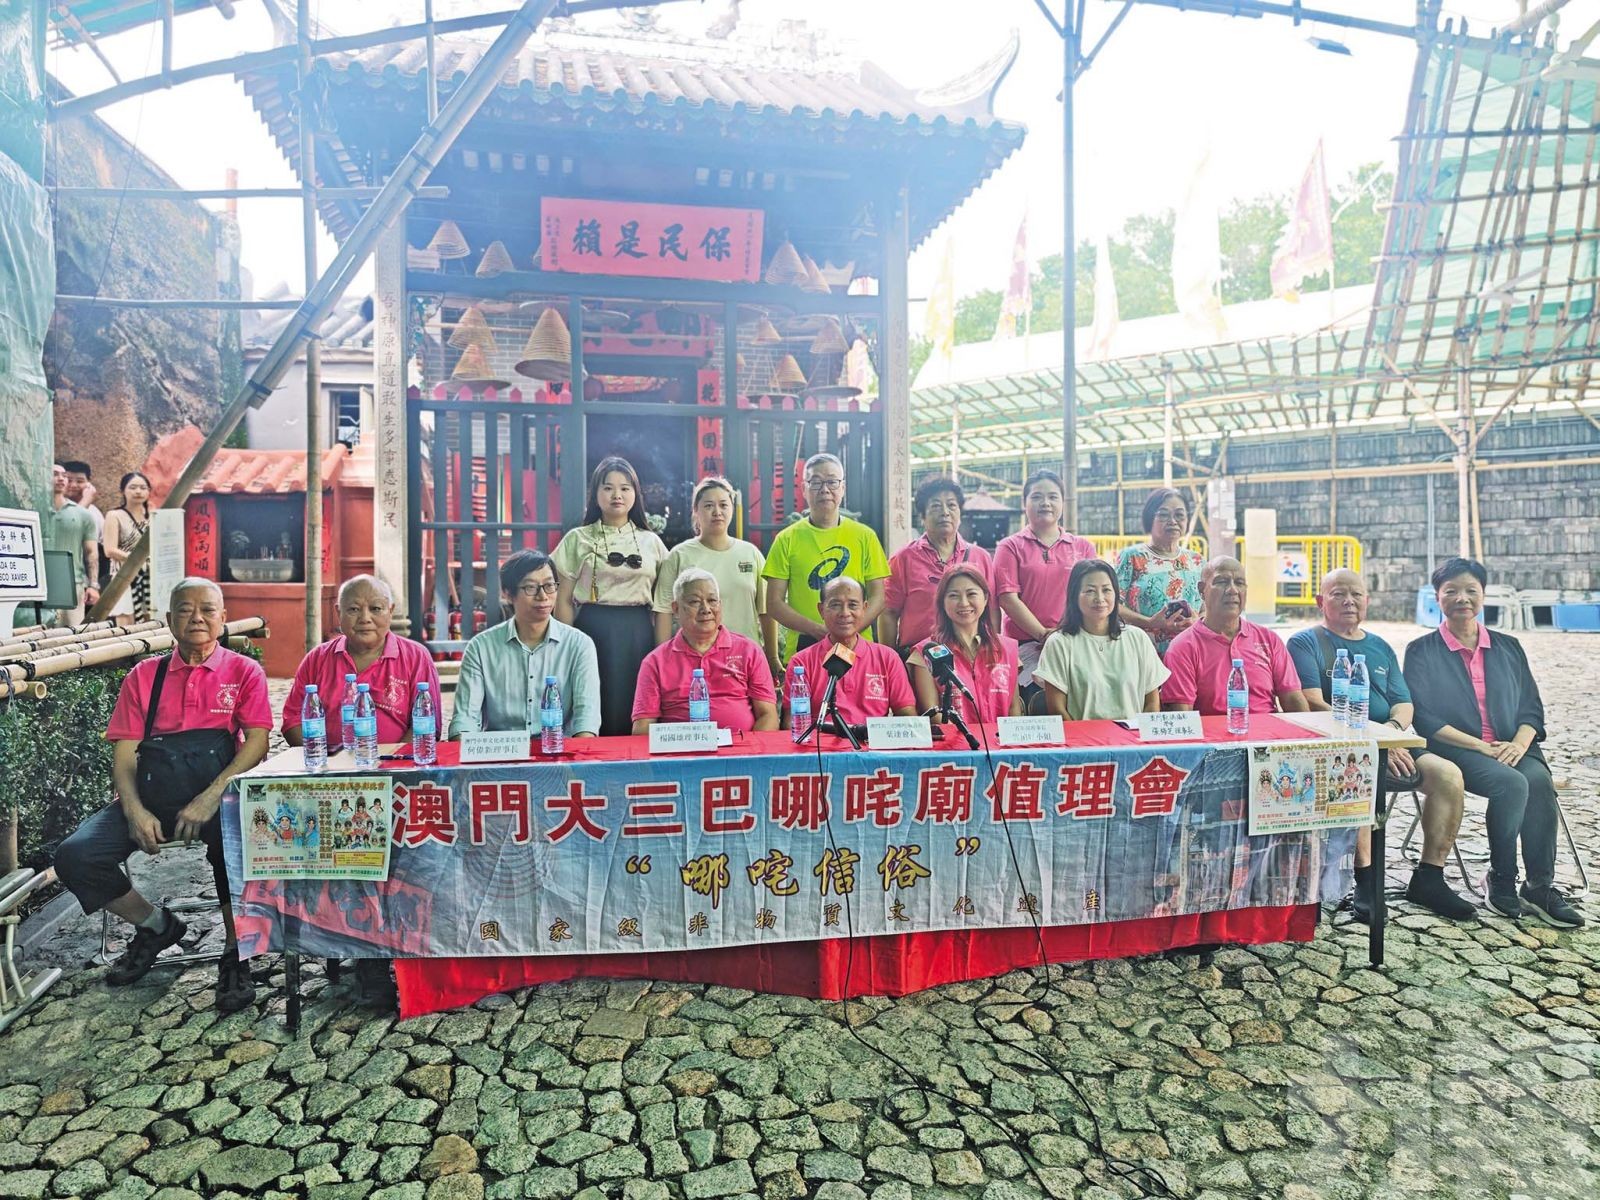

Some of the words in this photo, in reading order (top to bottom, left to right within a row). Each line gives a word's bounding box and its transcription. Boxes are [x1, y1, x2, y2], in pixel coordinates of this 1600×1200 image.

[10, 561, 17, 570] DE
[11, 573, 28, 581] XAVIER
[391, 757, 1189, 847] 澳門大三巴哪咤廟值理會
